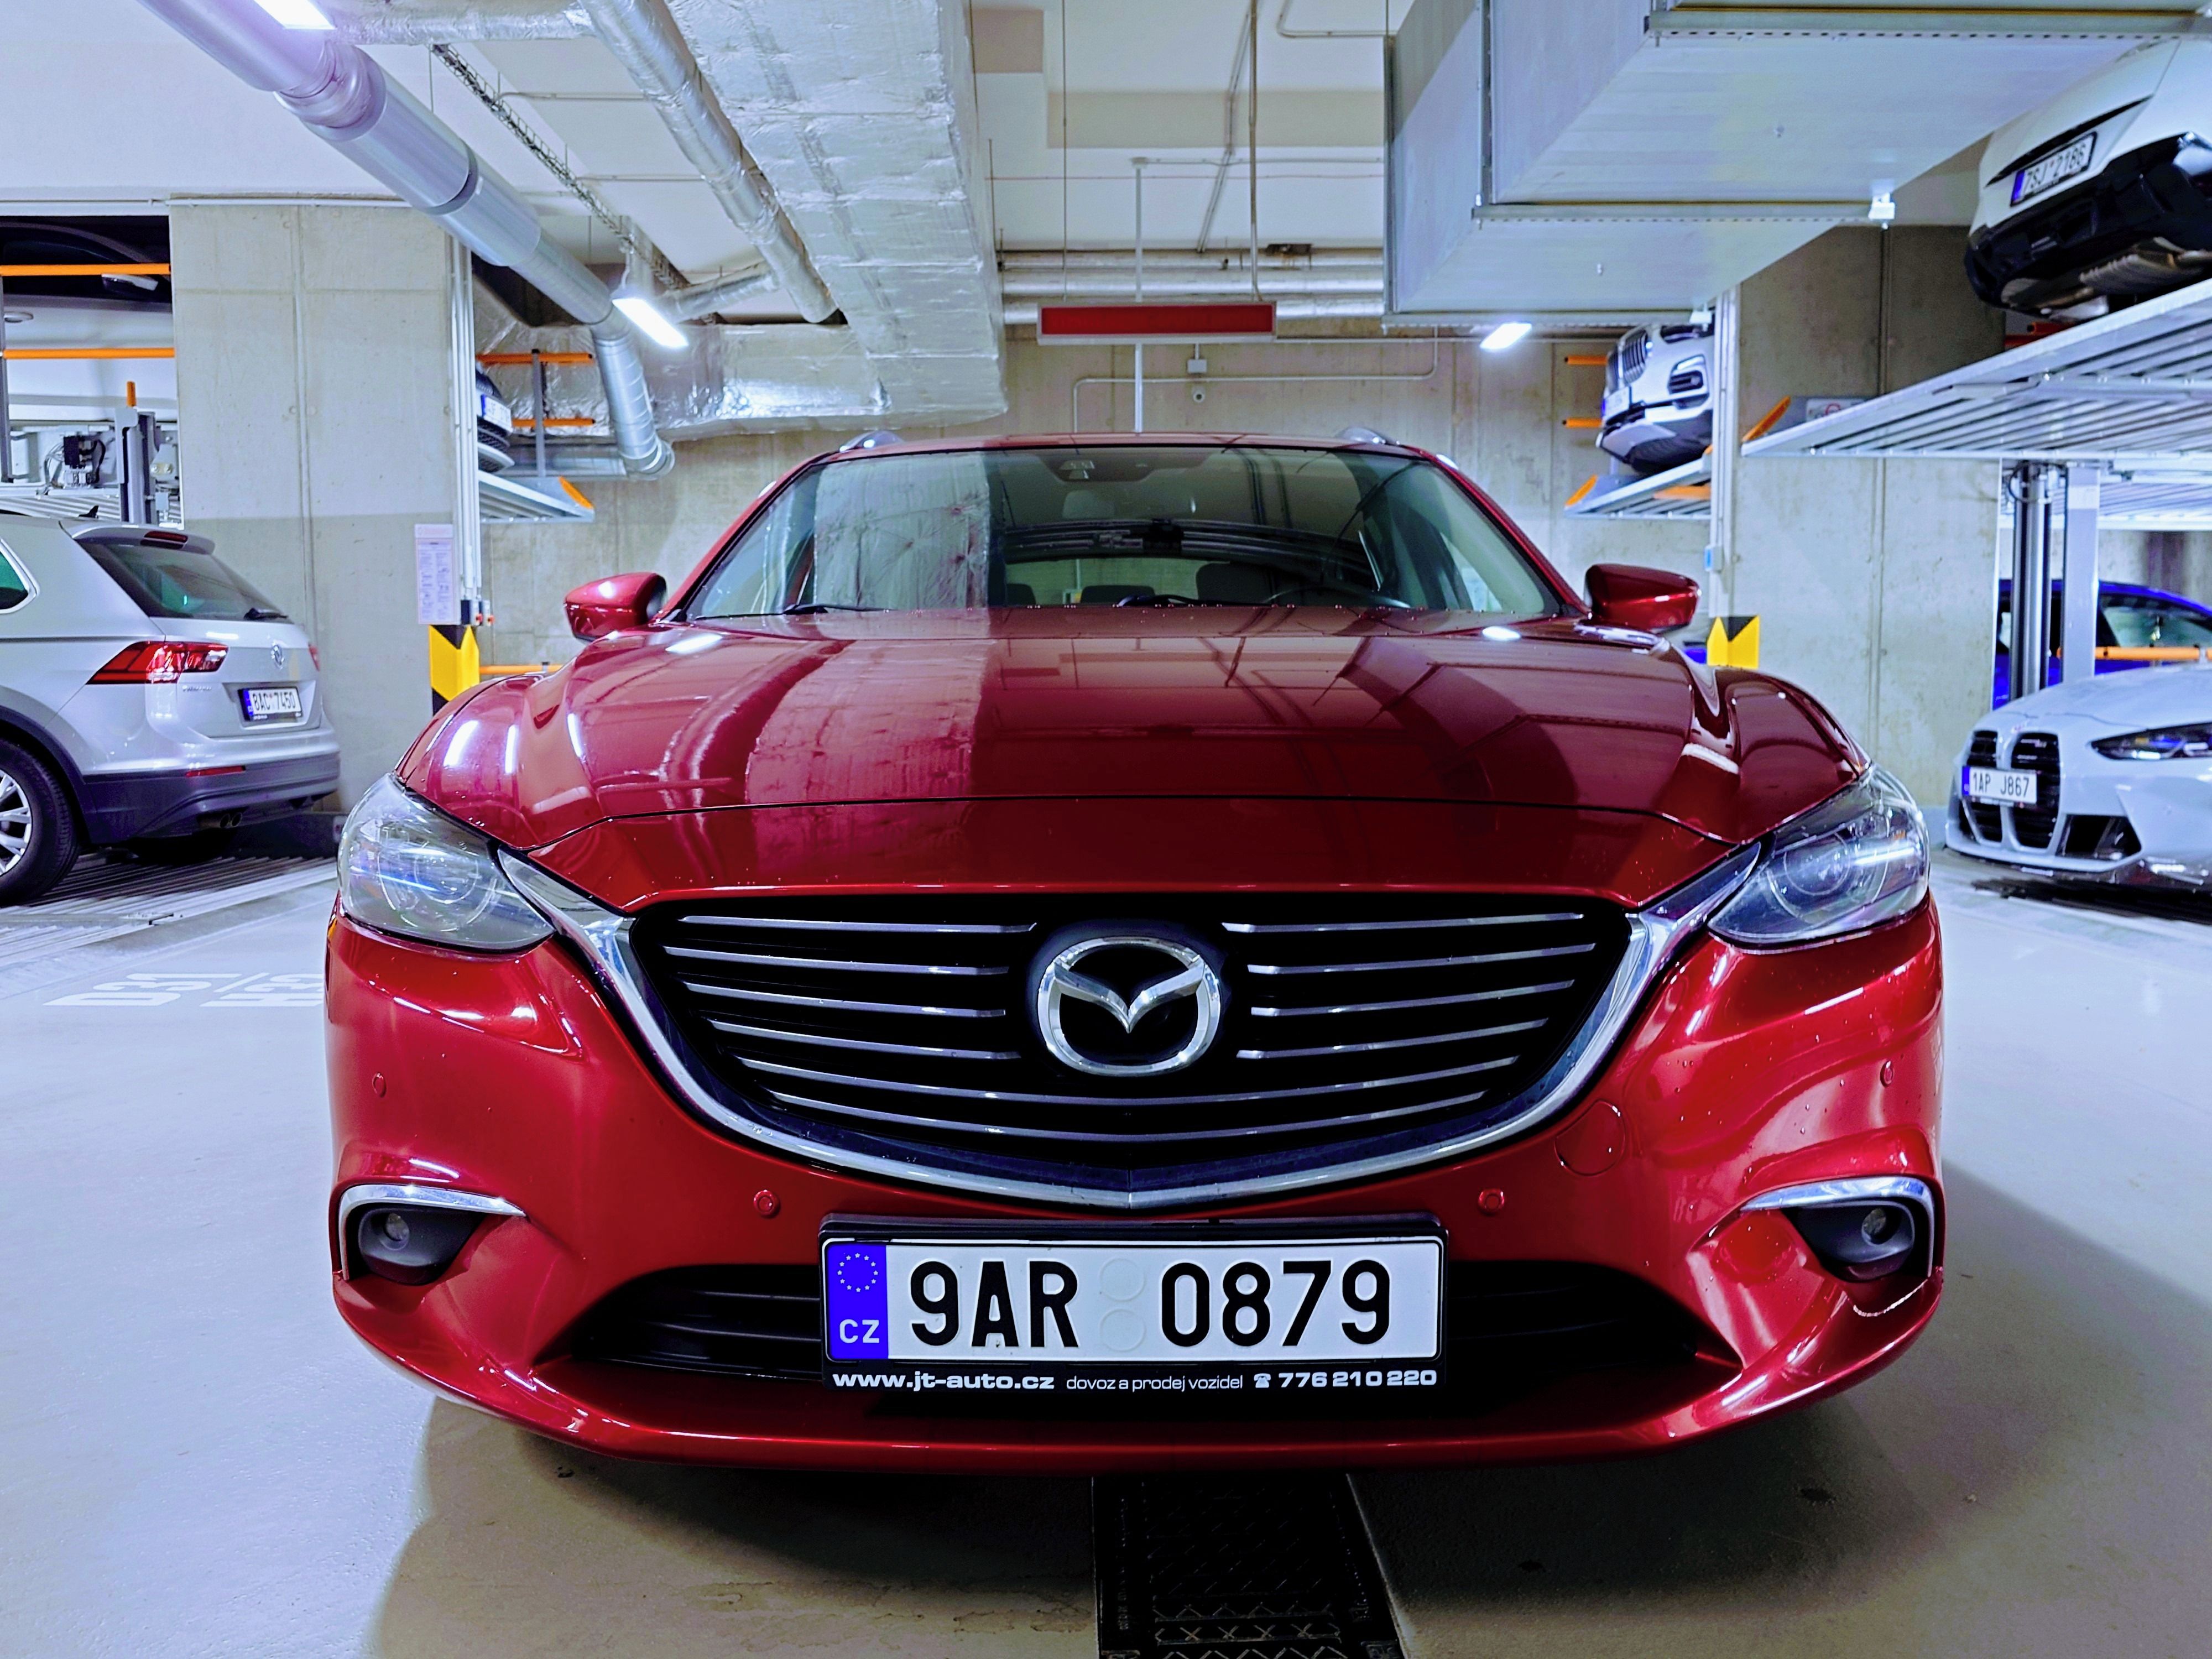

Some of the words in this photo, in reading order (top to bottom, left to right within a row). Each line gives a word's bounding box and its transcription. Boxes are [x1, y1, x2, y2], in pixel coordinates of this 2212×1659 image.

[274, 691, 296, 709] 7450
[1973, 772, 1991, 793] 1AP
[2000, 774, 2030, 797] J867
[910, 1260, 1079, 1348] 9AR
[1161, 1259, 1391, 1347] 0879
[839, 1319, 880, 1344] CZ
[832, 1370, 1055, 1392] www.jt-auto.cz
[1066, 1375, 1116, 1390] dovoz
[1118, 1379, 1129, 1390] a
[1132, 1375, 1185, 1392] prodej
[1188, 1374, 1243, 1390] vozidel
[1278, 1371, 1328, 1388] 776
[1332, 1371, 1383, 1387] 210
[1386, 1370, 1437, 1386] 220
